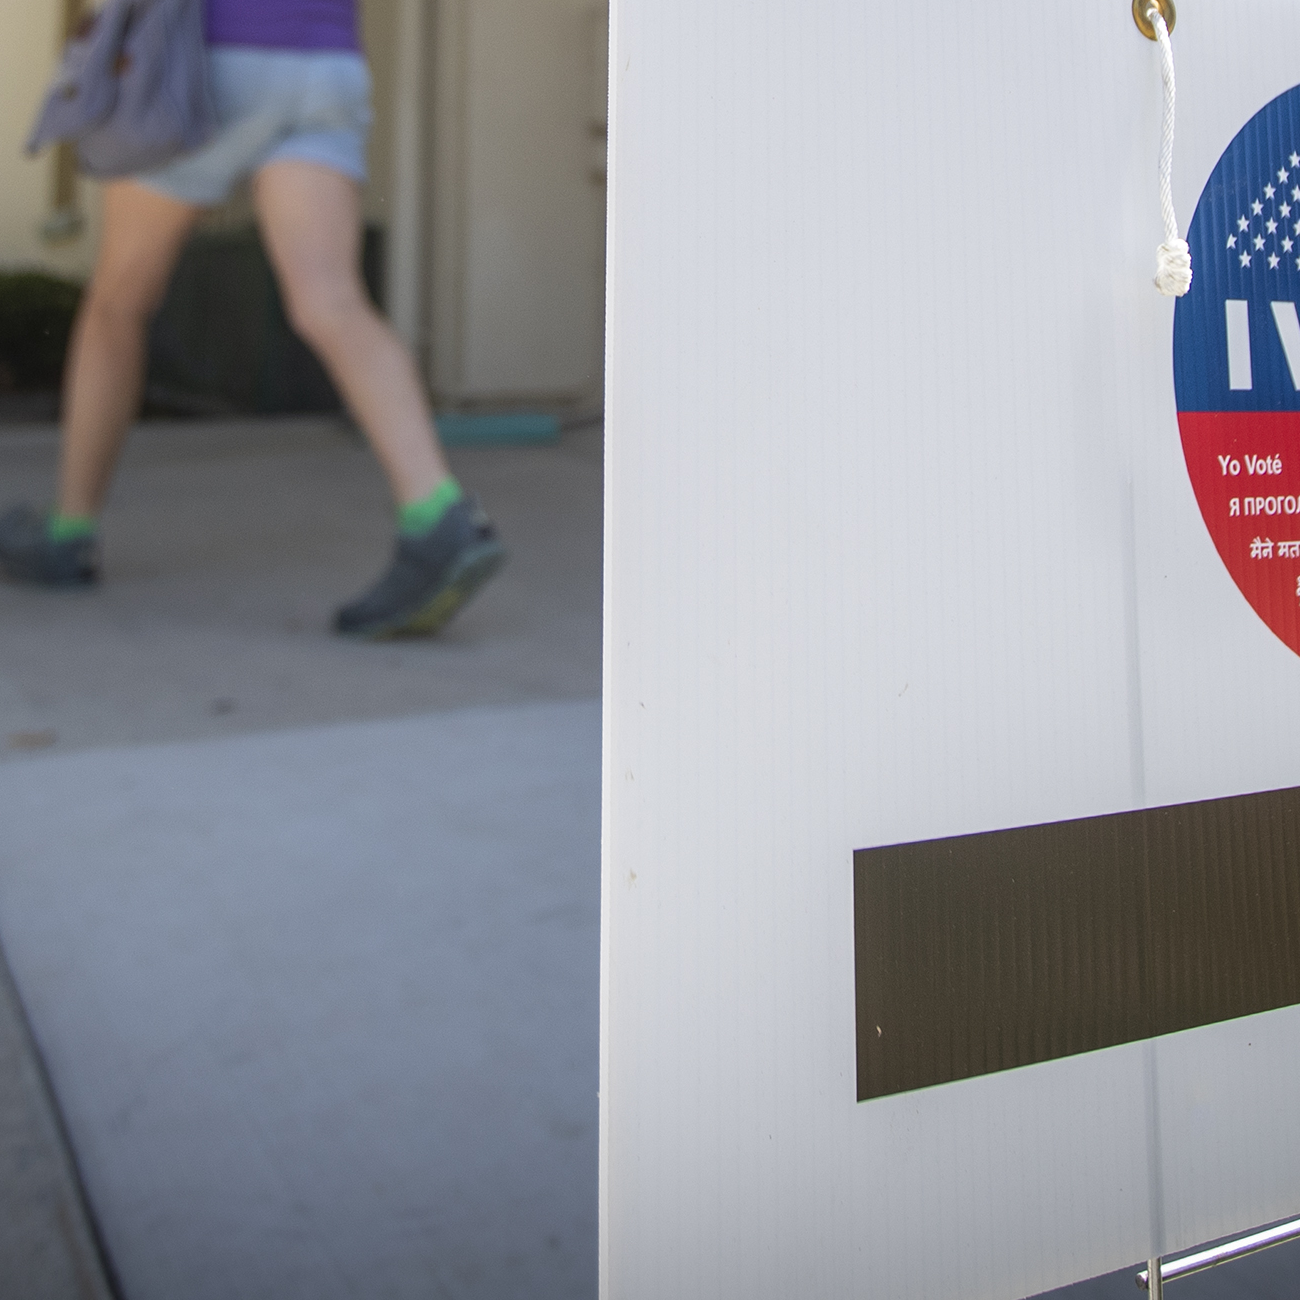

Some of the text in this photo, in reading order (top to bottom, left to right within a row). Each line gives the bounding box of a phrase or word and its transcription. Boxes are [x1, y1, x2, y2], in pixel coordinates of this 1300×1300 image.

[1225, 299, 1252, 391] I
[1217, 453, 1283, 476] Yo Voté
[1229, 498, 1240, 516] Я
